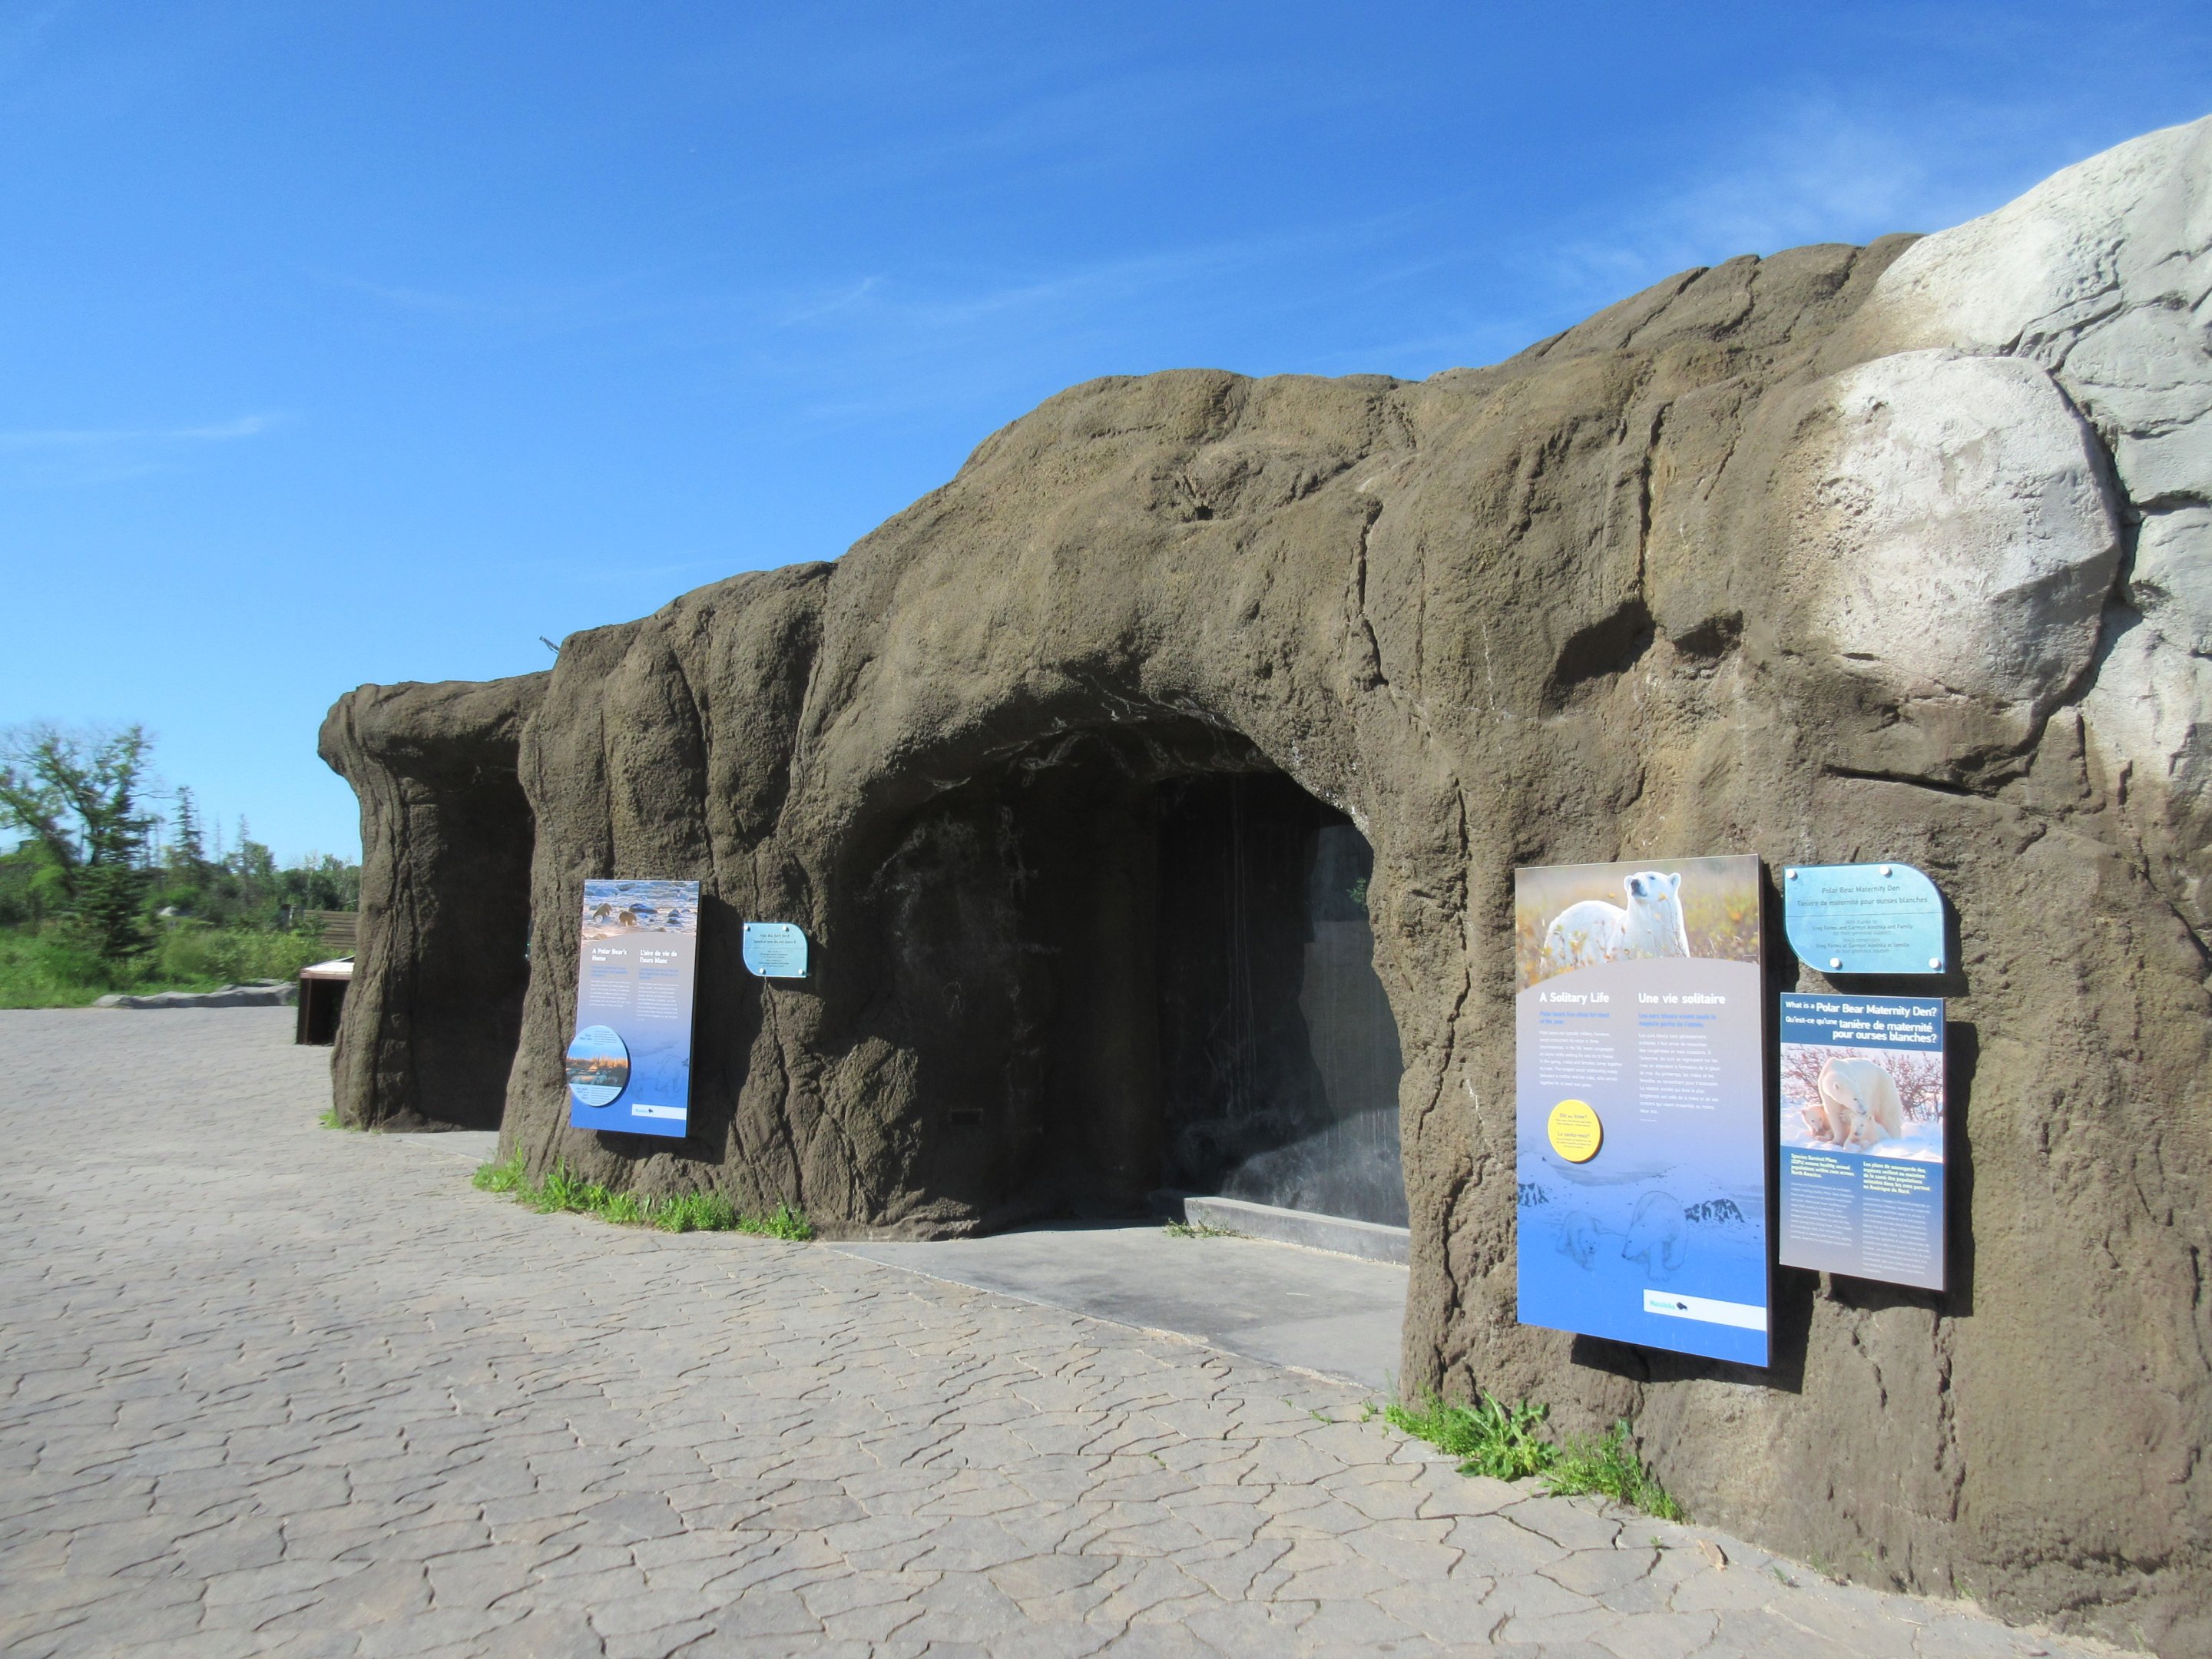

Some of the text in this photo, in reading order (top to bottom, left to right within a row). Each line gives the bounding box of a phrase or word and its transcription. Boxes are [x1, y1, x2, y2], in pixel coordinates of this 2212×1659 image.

[1856, 885, 1886, 893] Maternity
[1539, 992, 1610, 1005] A Solitary Life
[1638, 992, 1726, 1005] Une vie solitaire
[1816, 1002, 1840, 1013] Polar
[1843, 1003, 1864, 1014] Bear
[1866, 1004, 1910, 1018] Maternity
[1912, 1006, 1937, 1017] Den?
[1785, 1016, 1932, 1033] Qu'est-ce qu'une tanière de maternité
[1833, 1031, 1937, 1043] pour ourses blanches?
